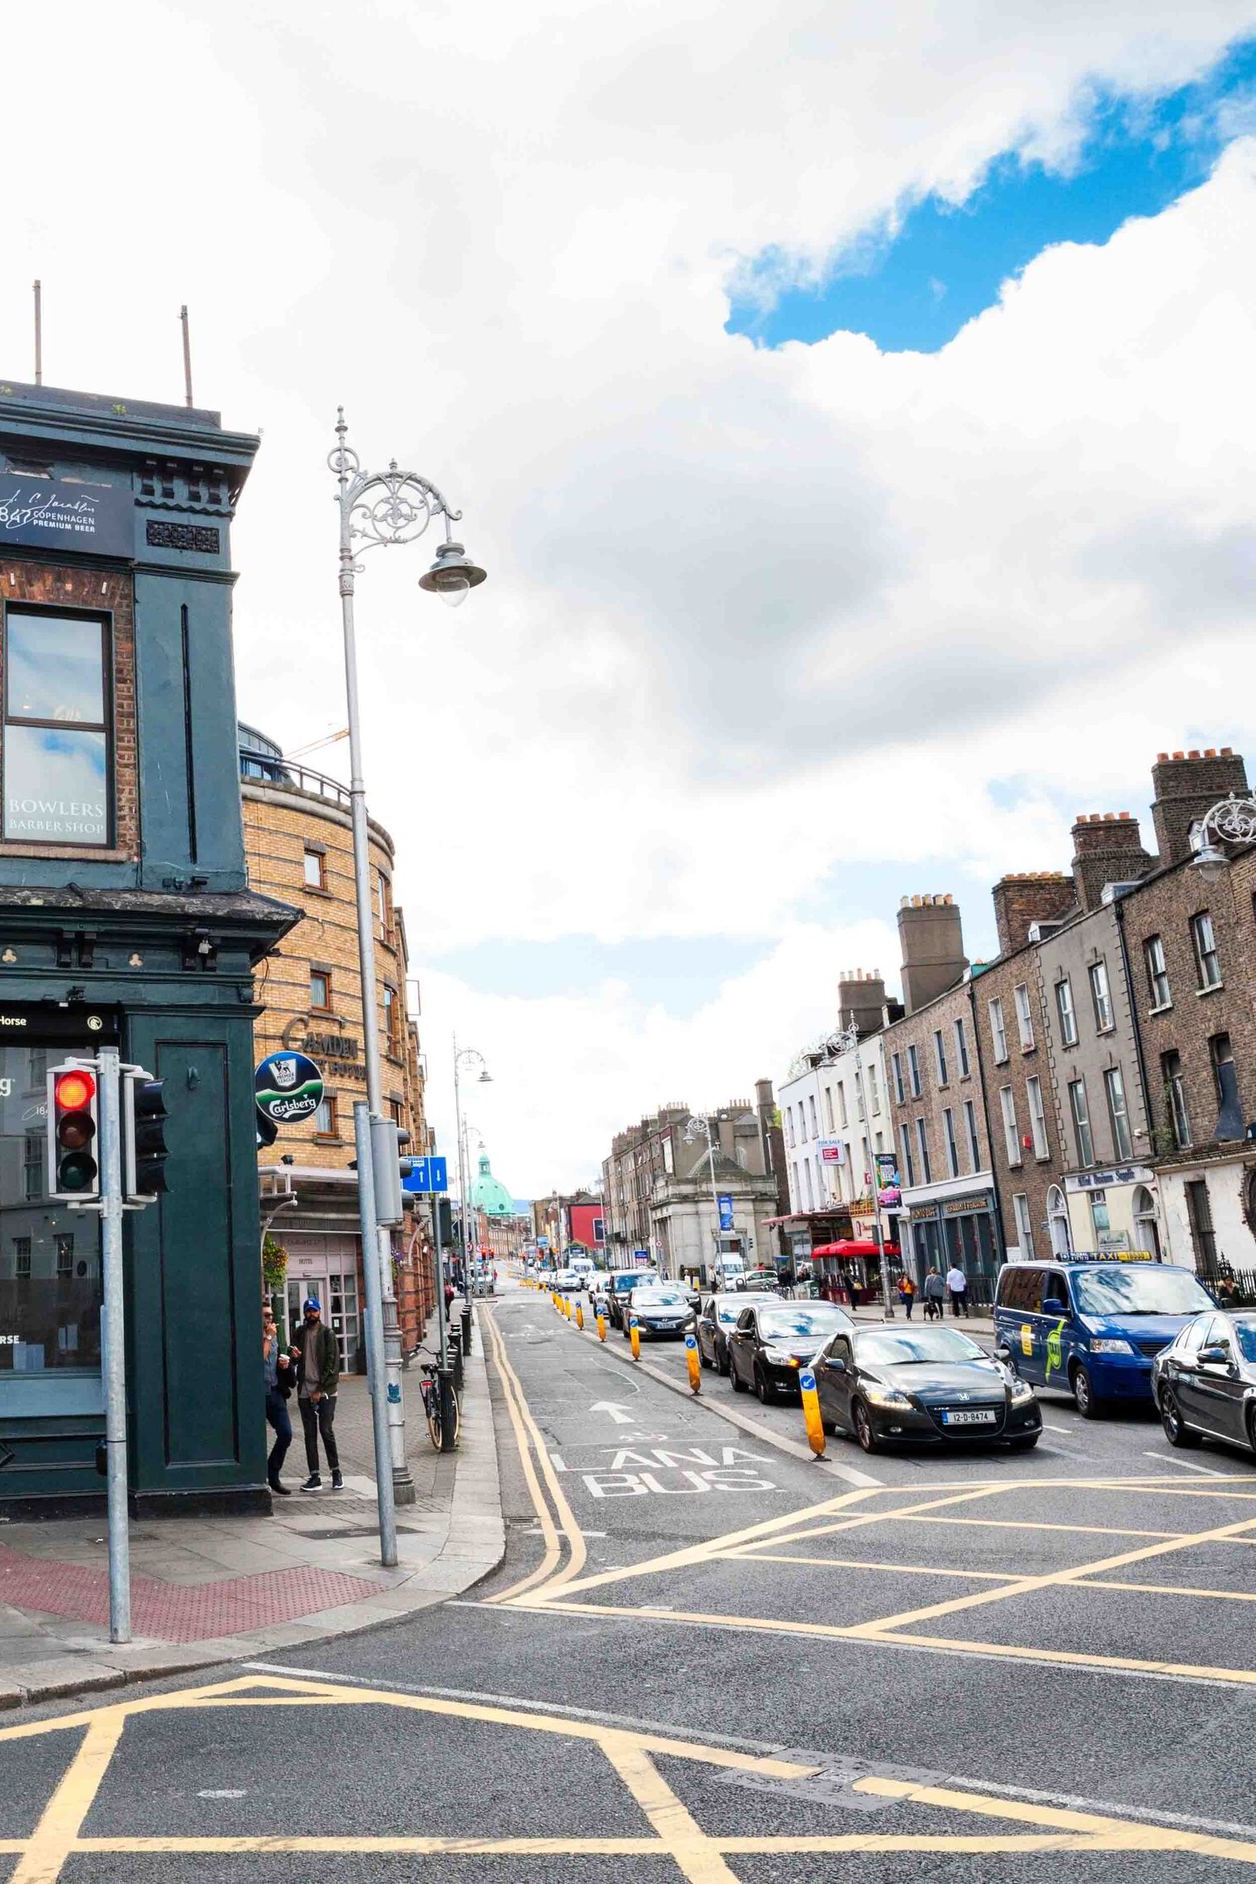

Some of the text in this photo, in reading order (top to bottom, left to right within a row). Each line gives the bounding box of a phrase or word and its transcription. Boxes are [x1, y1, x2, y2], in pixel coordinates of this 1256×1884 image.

[33, 510, 95, 525] COPENHAGEN
[33, 519, 96, 533] PREMIUM BEER
[9, 799, 104, 818] BOWLERS
[9, 819, 105, 835] BARBER SHOP
[269, 1095, 317, 1119] Carlsberg
[1092, 1251, 1118, 1260] TAXI
[582, 1469, 777, 1498] BUS
